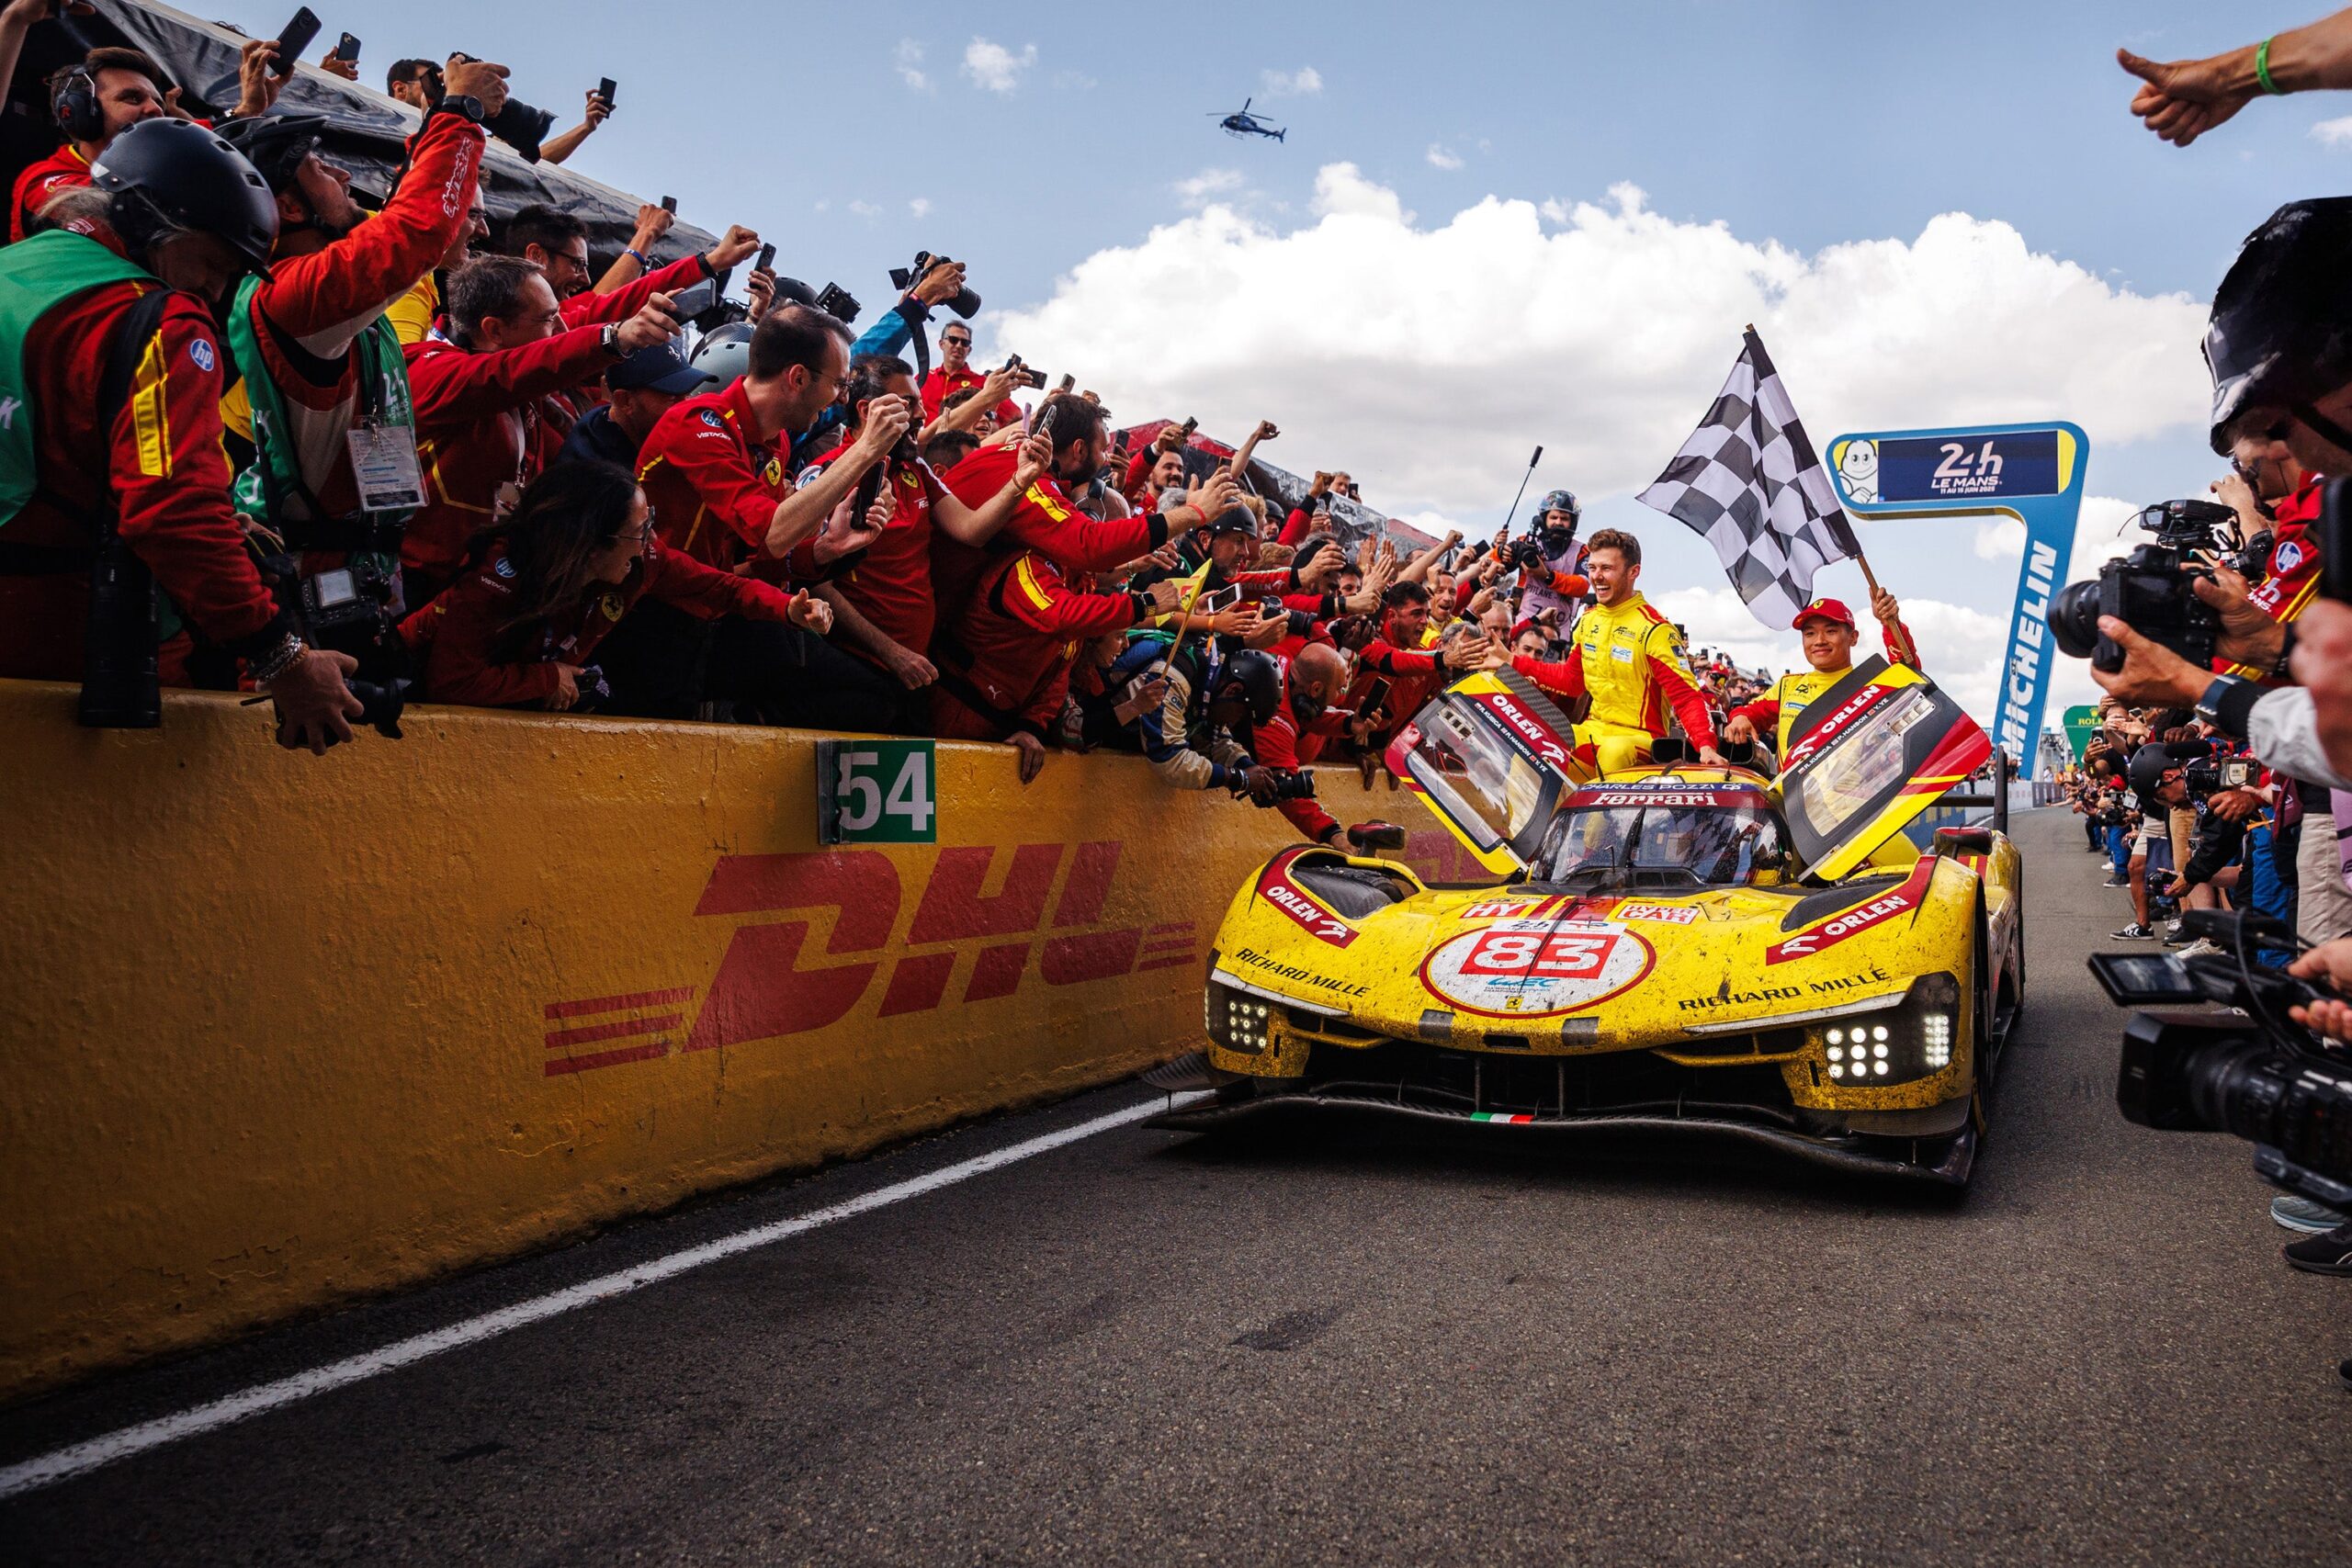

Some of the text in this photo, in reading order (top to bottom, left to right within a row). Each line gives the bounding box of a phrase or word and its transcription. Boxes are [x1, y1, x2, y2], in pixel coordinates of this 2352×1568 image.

[194, 340, 214, 370] hp
[704, 411, 722, 427] hp
[1934, 441, 2003, 478] 24h
[1931, 478, 1951, 489] LE
[2278, 541, 2301, 571] hp
[1998, 539, 2057, 764] MICHELIN
[1492, 694, 1544, 741] ORLEN
[1821, 684, 1882, 734] ORLEN
[2078, 717, 2103, 727] ROLE
[837, 750, 935, 832] 54
[1581, 783, 1715, 791] CHARLES POZZI
[1589, 792, 1718, 807] Ferrari
[1266, 886, 1323, 922] ORLEN
[1623, 910, 1689, 922] CAR
[1824, 895, 1909, 936] ORLEN
[681, 840, 1144, 1055] DHL
[1473, 936, 1608, 971] 83
[1236, 948, 1372, 998] RICHARD MILLE
[1487, 976, 1561, 987] WEC
[1678, 967, 1892, 1011] RICHARD MILLE
